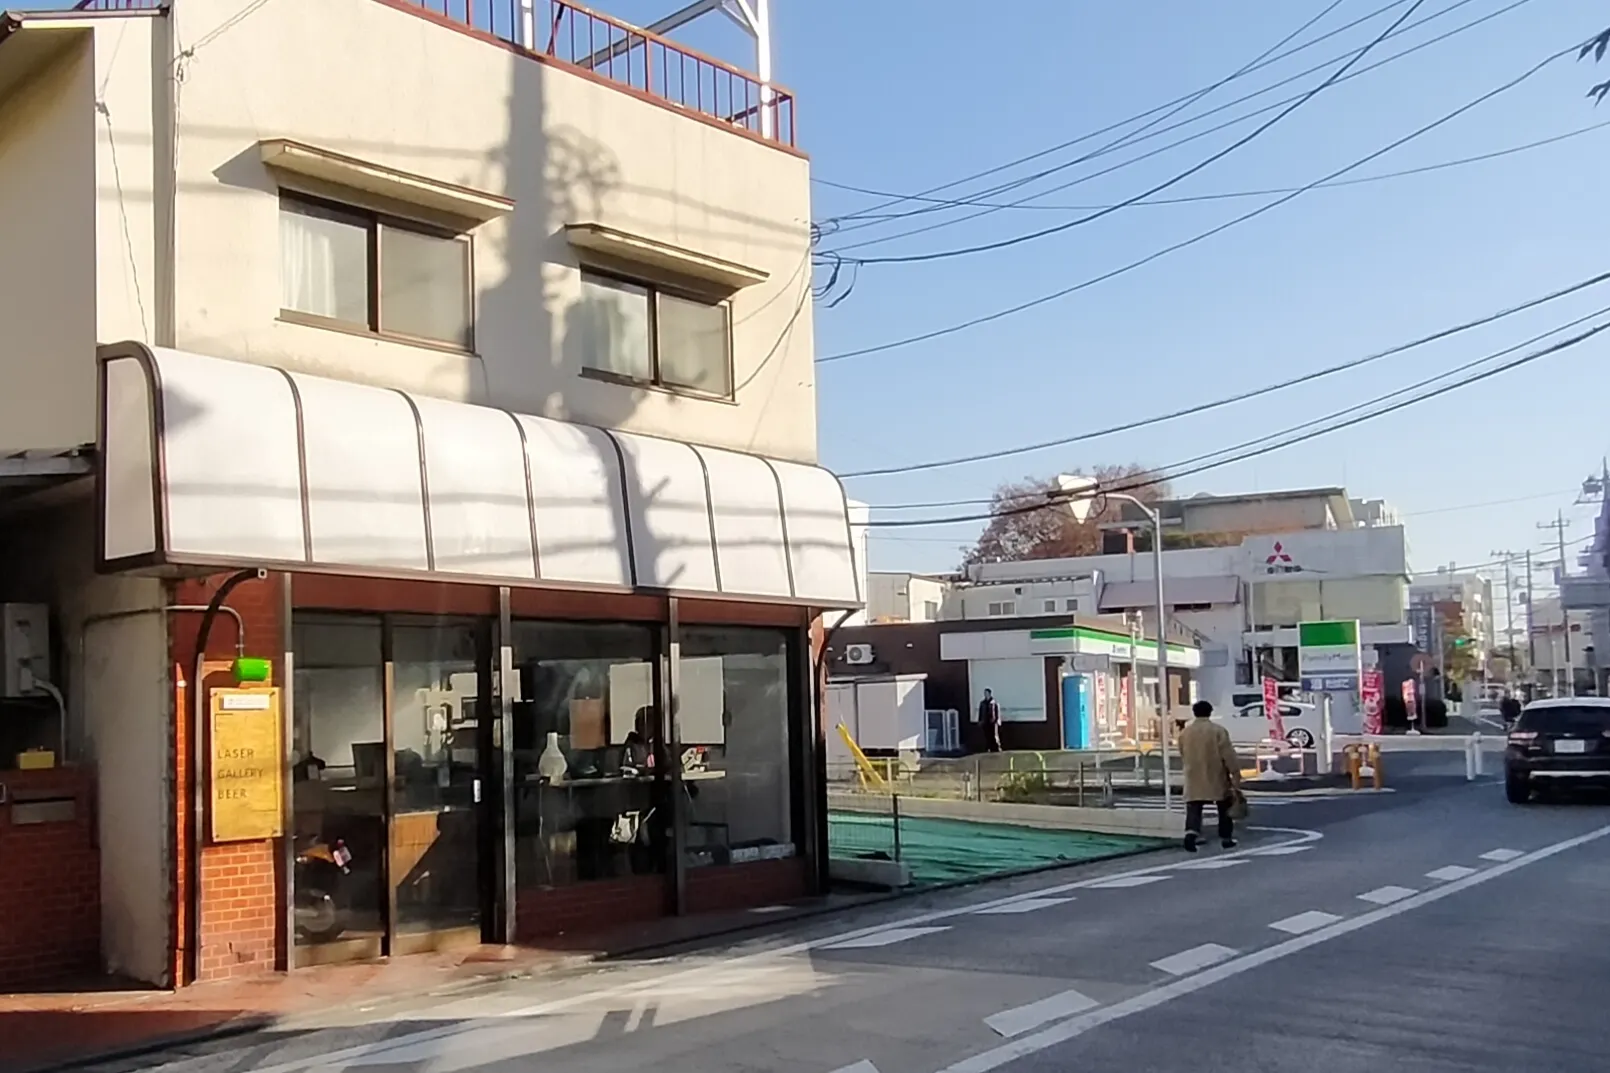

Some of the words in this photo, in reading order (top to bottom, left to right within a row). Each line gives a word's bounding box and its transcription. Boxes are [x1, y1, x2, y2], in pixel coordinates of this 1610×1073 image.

[217, 747, 254, 759] LASER
[217, 767, 264, 779] GALLERY
[217, 788, 248, 800] BEER
